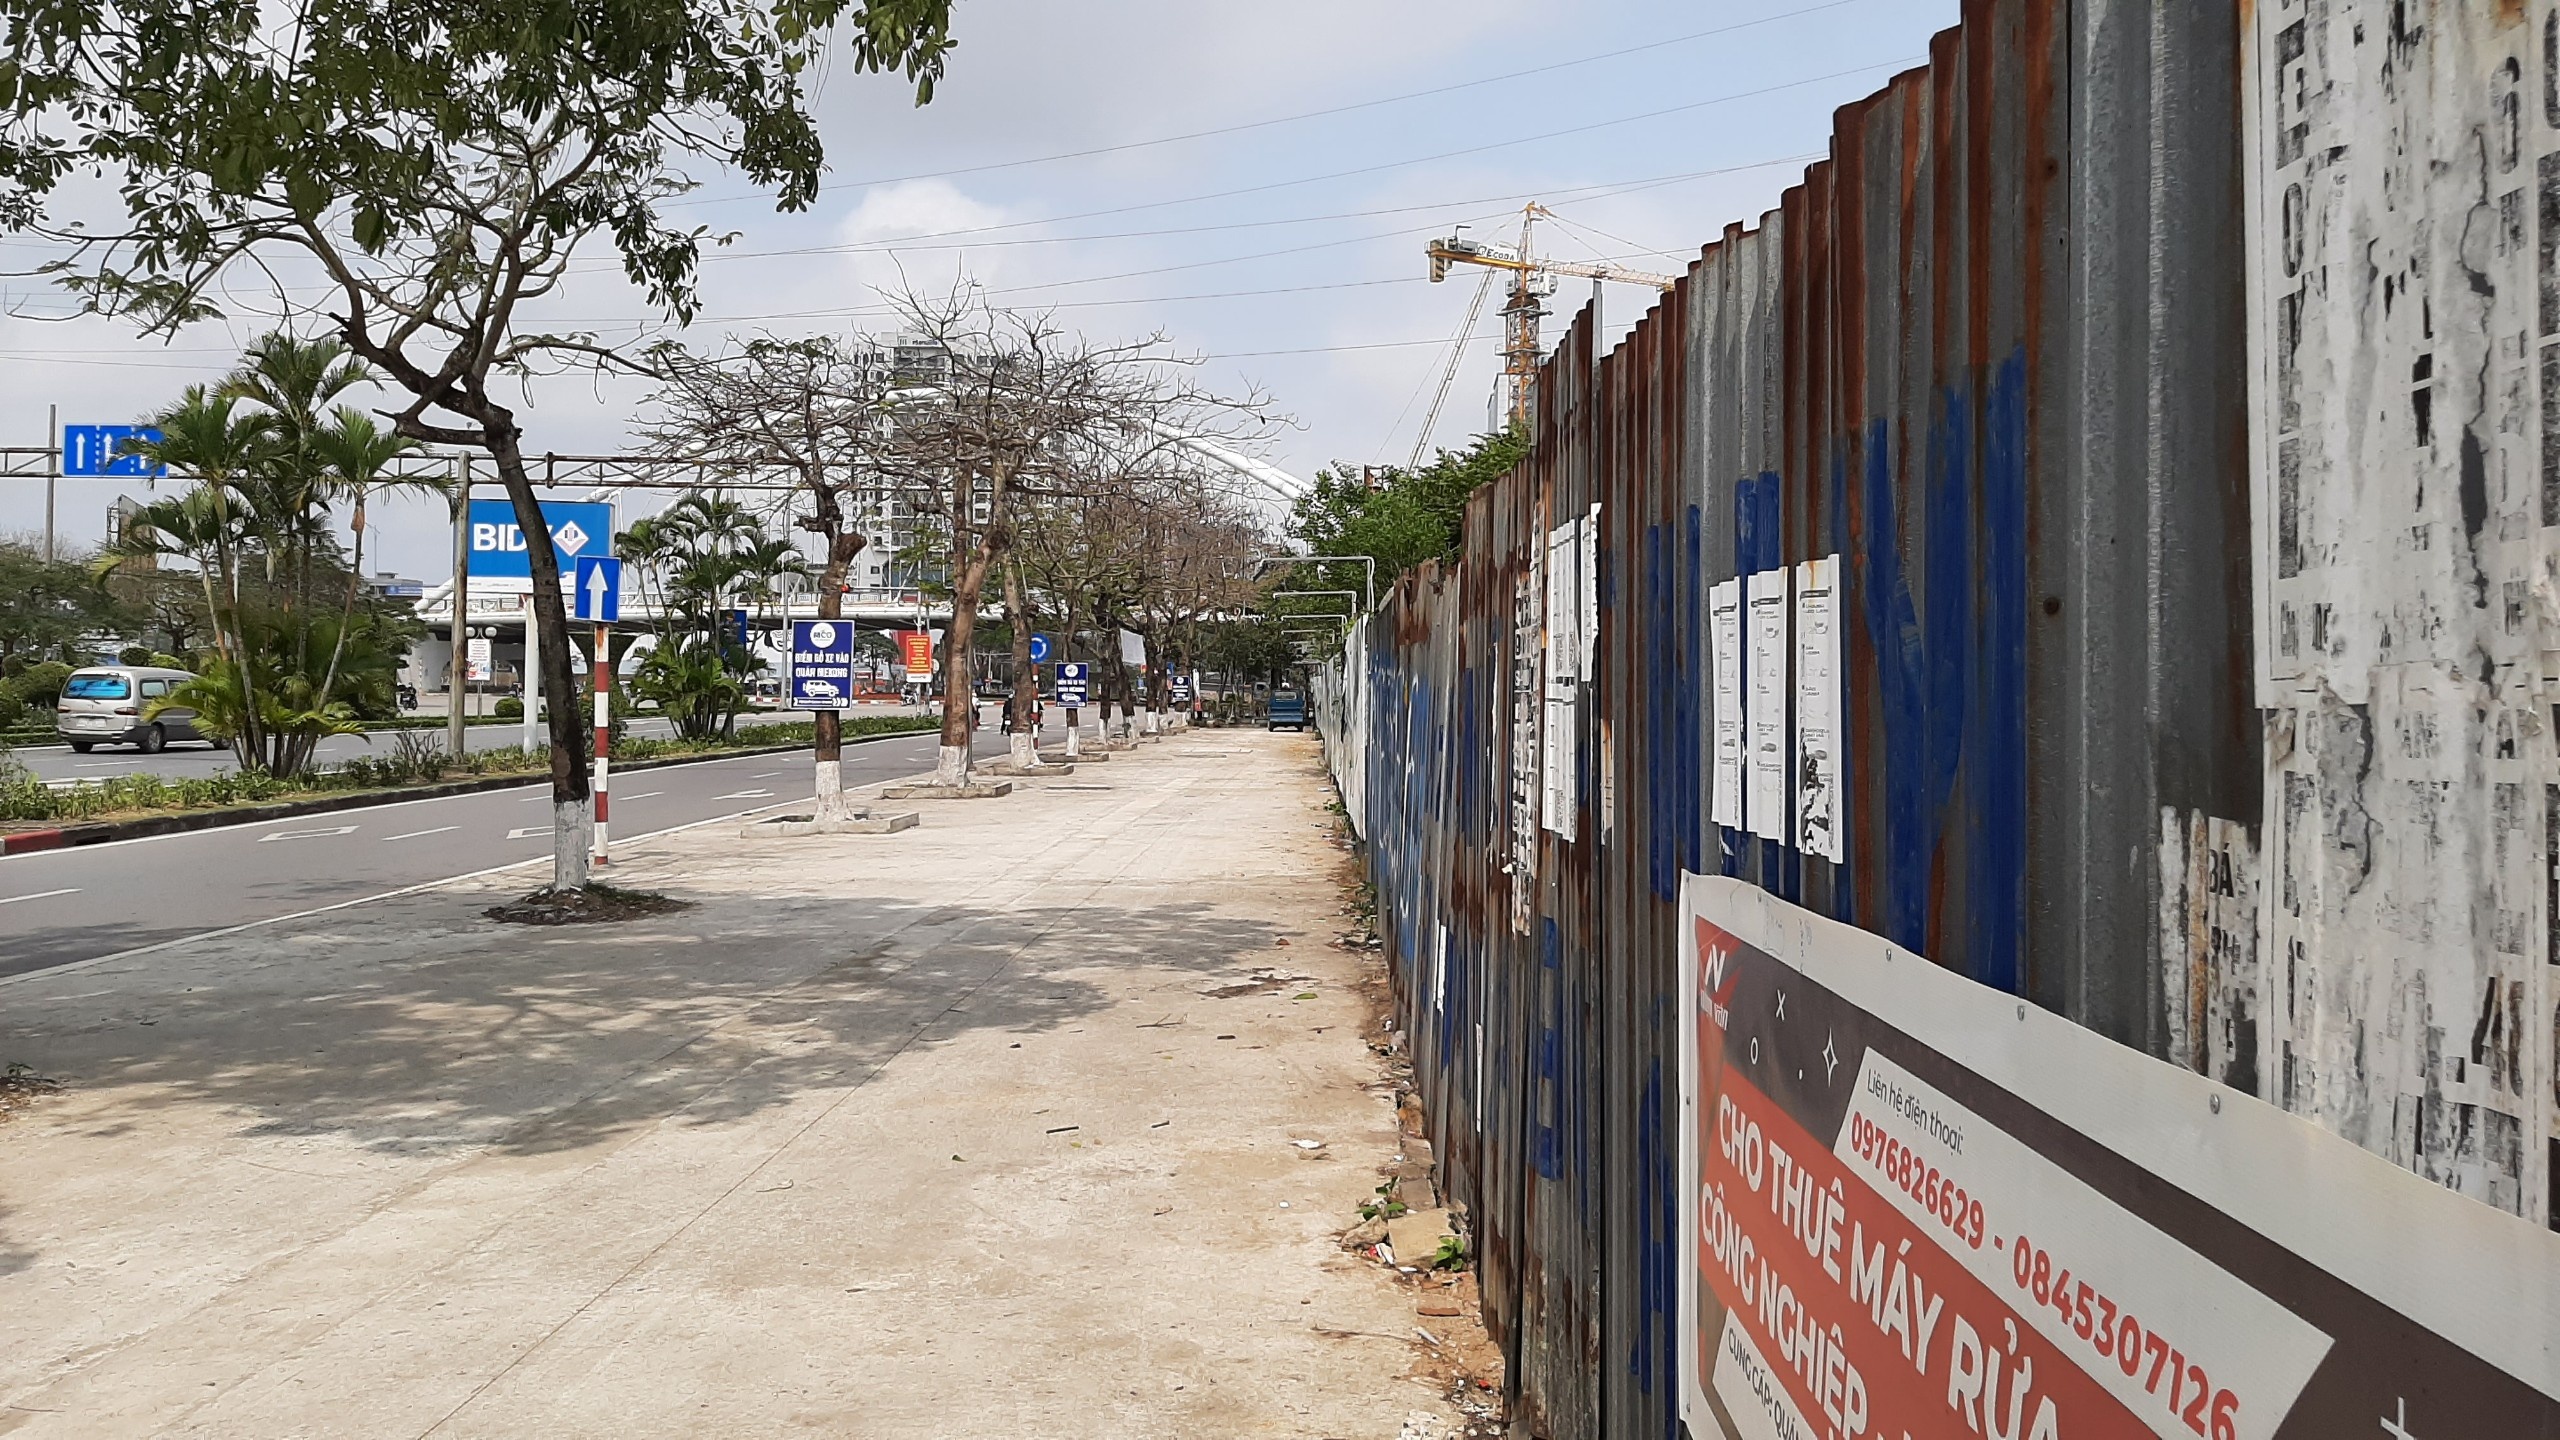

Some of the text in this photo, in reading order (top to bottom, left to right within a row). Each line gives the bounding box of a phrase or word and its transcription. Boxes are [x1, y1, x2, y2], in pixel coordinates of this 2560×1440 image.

[473, 523, 552, 551] BID
[1719, 1094, 1763, 1192] CHO
[1769, 1139, 1845, 1284] THUÊ
[1850, 1220, 1945, 1376] MÁY
[1867, 1068, 1964, 1155] Liên hệ điện thoại:
[1702, 1181, 1867, 1440] CÔNG NGHIỆP
[1852, 1111, 1985, 1250] 0976826629
[2013, 1235, 2240, 1440] 0845307126
